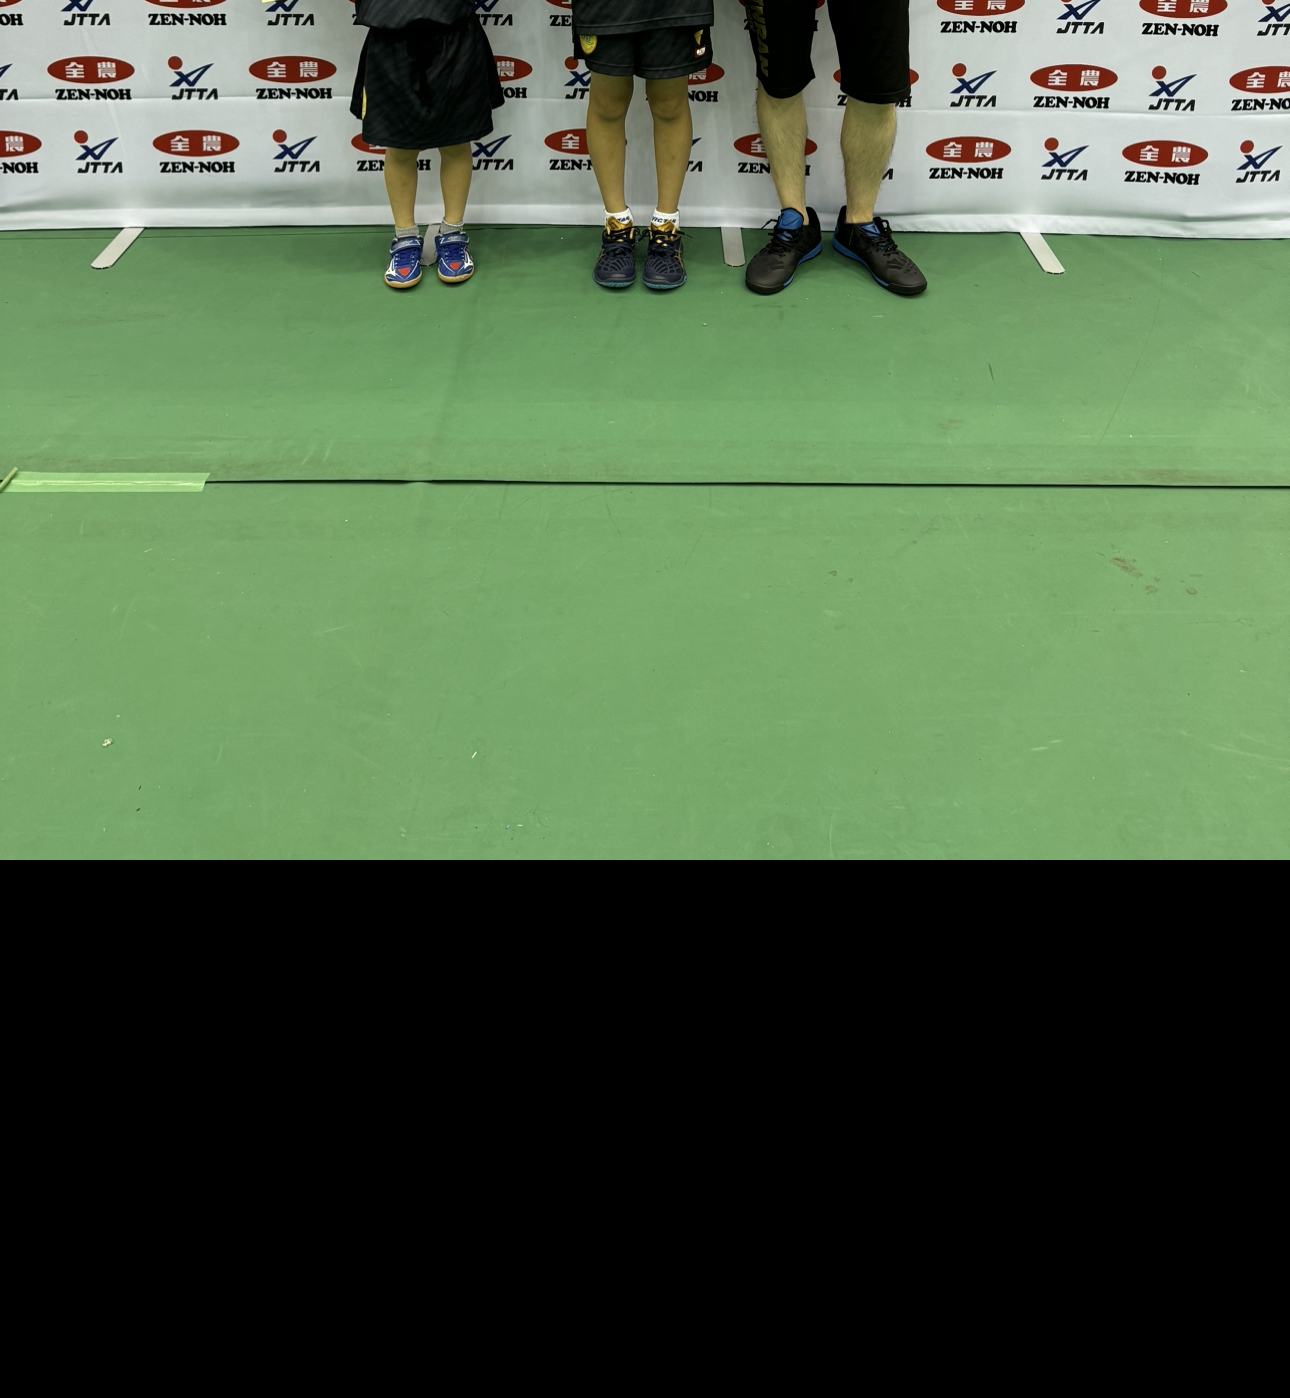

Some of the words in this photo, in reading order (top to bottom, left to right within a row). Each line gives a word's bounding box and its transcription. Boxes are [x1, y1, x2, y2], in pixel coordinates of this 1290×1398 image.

[64, 14, 110, 25] JTTA
[267, 14, 314, 25] JTTA
[941, 21, 1017, 33] ZEN-NOH
[1057, 22, 1104, 34] JTTA
[1142, 23, 1219, 36] ZEN-NOH
[267, 61, 318, 78] 全農
[1048, 70, 1099, 86] 全農
[55, 89, 131, 100] ZEN-NOH
[172, 89, 218, 99] JTTA
[950, 95, 996, 107] JTTA
[1033, 96, 1110, 108] ZEN-NOH
[1149, 99, 1195, 111] JTTA
[171, 135, 221, 151] 全農
[944, 142, 993, 157] 全農
[78, 162, 122, 173] JTTA
[160, 162, 235, 173] ZEN-NOH
[275, 161, 319, 172] JTTA
[929, 168, 1003, 179] ZEN-NOH
[1124, 171, 1200, 185] ZEN-NOH
[1236, 170, 1280, 183] JTTA
